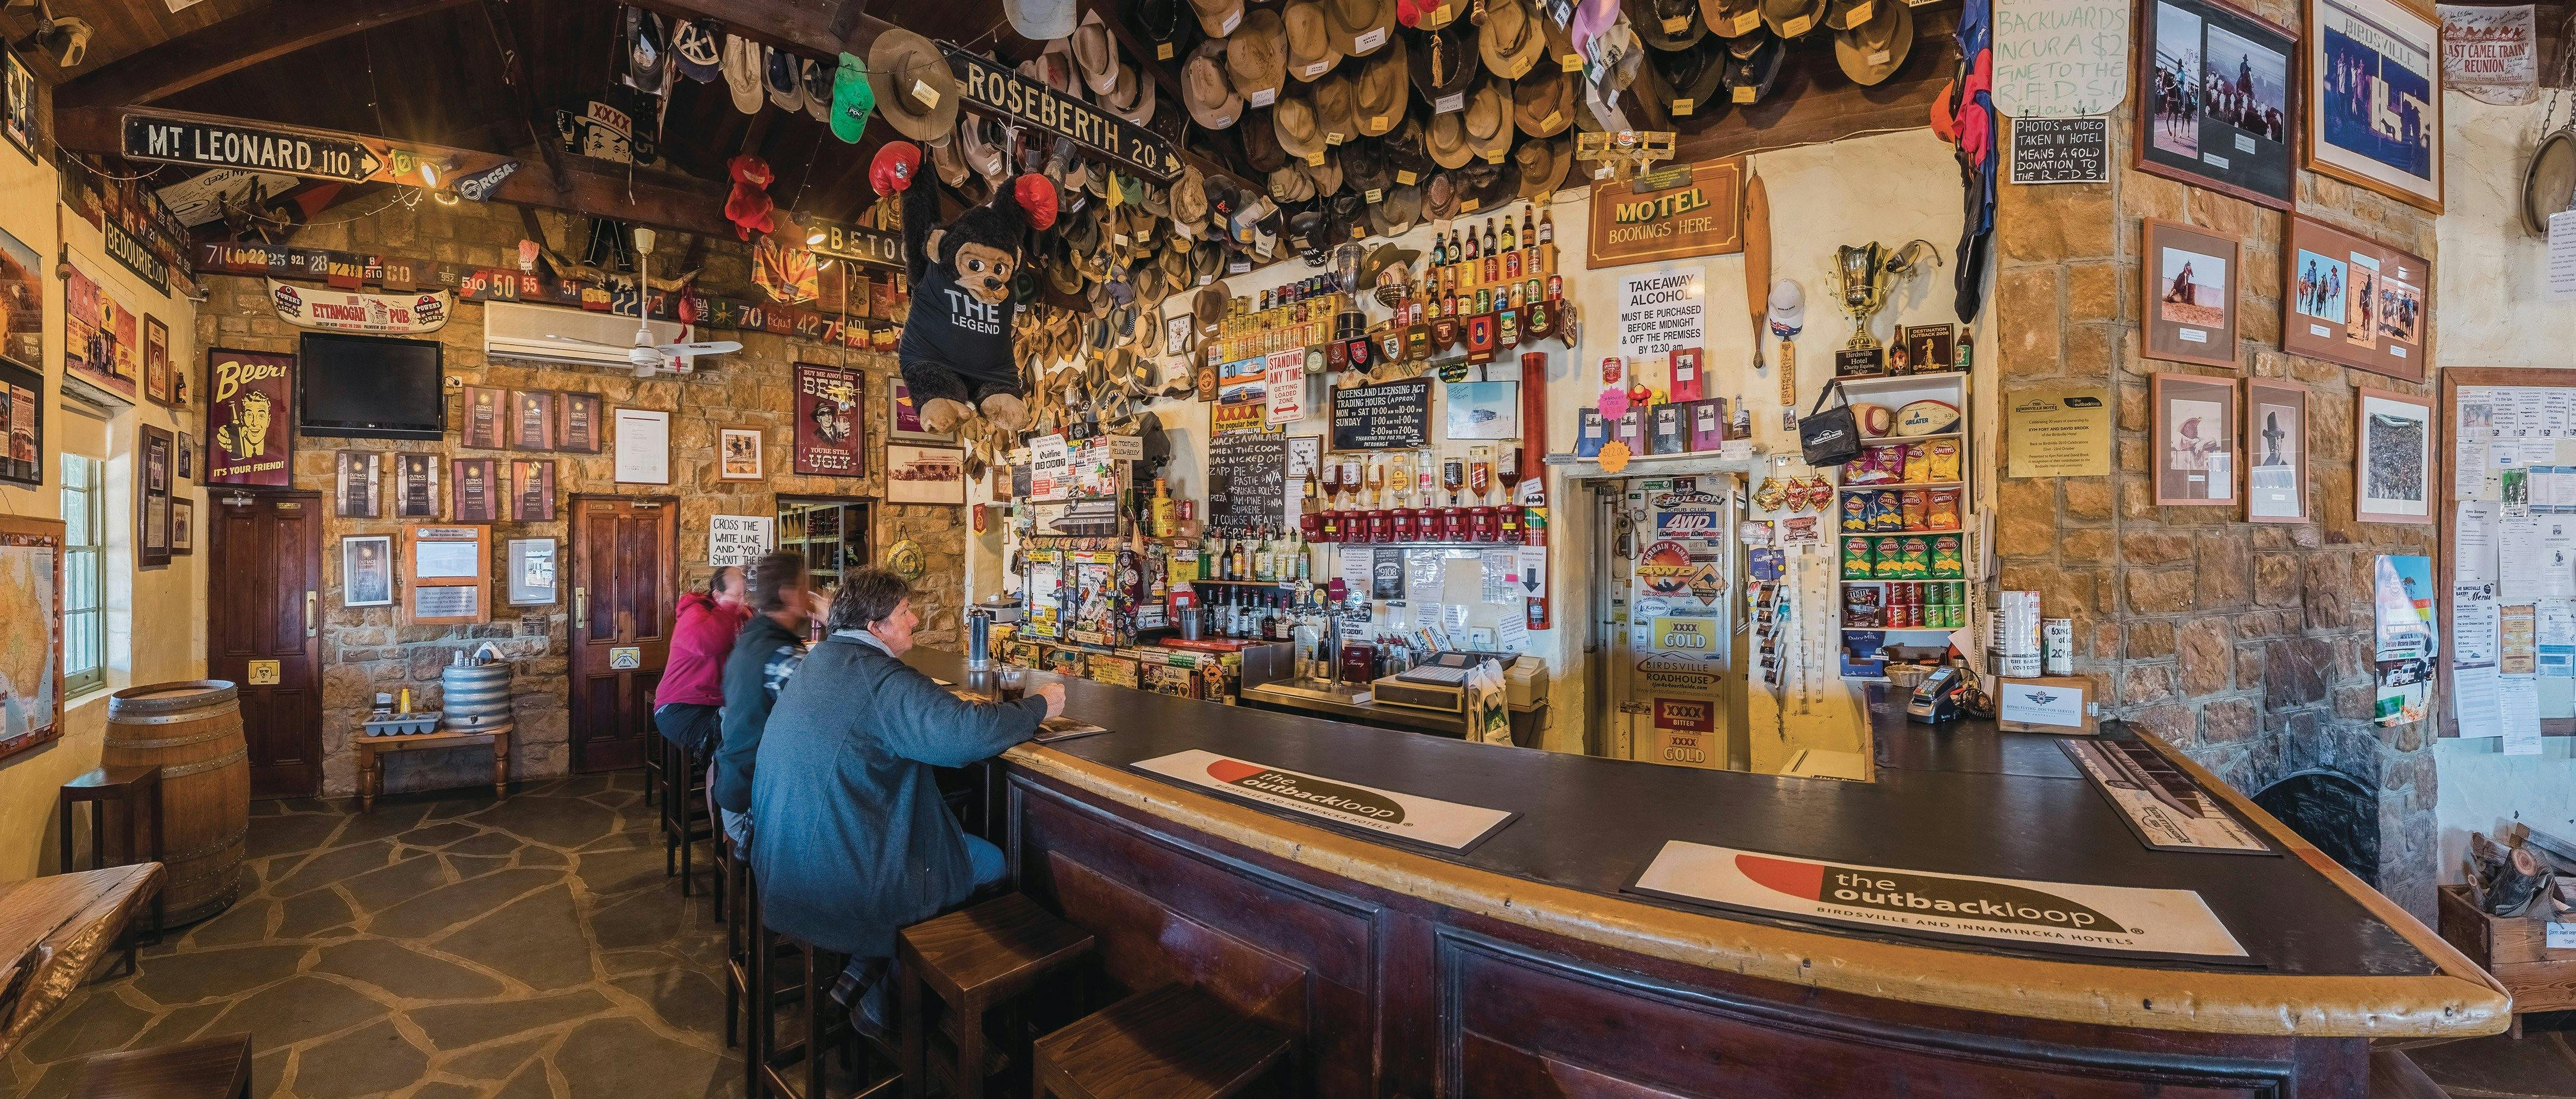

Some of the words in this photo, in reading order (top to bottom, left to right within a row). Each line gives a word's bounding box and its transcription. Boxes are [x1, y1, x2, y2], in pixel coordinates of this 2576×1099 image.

[1997, 8, 2126, 36] BACKWARDS
[2091, 32, 2124, 60] $2
[2344, 17, 2414, 68] BIRDSVILLE
[2468, 45, 2496, 58] CAMEL
[1997, 62, 2038, 82] FINE
[2044, 60, 2073, 79] TO
[2081, 62, 2123, 78] THE
[2464, 60, 2505, 73] REUNION
[594, 104, 630, 133] XXXX
[968, 62, 1119, 154] ROSEBERTH
[1132, 138, 1155, 167] 20
[2074, 121, 2104, 130] VIDEO
[2019, 133, 2051, 145] TAKEN
[2057, 134, 2065, 144] IN
[2070, 132, 2102, 143] HOTEL
[195, 129, 312, 171] LEONARD
[322, 150, 350, 176] 110
[2018, 148, 2054, 159] MEANS
[2061, 148, 2068, 158] A
[2070, 147, 2099, 158] GOLD
[2017, 159, 2073, 171] DONATION
[2080, 159, 2096, 168] TO
[1616, 188, 1709, 222] MOTEL
[1609, 222, 1671, 244] BOOKINGS
[107, 222, 152, 277] BEDOURIE
[152, 262, 163, 285] 120
[268, 251, 286, 267] 25
[290, 255, 305, 265] 921
[311, 255, 327, 272] 28
[462, 277, 486, 290] 510
[493, 274, 514, 298] 50
[523, 277, 537, 292] 55
[1629, 274, 1694, 292] TAKEAWAY
[1631, 289, 1692, 306] ALCOHOL
[277, 305, 297, 316] LIGHT
[312, 303, 366, 321] ETTAMOGAH
[389, 308, 410, 323] PUB
[944, 289, 999, 323] THE
[1622, 312, 1641, 321] MUST
[1644, 311, 1654, 319] BE
[1657, 305, 1701, 318] PURCHASED
[739, 305, 761, 327] 70
[797, 313, 818, 336] 42
[952, 314, 999, 334] LEGEND
[1628, 322, 1656, 332] BEFORE
[1660, 318, 1694, 329] MIDNIGHT
[1630, 334, 1644, 343] OFF
[1647, 333, 1660, 342] THE
[1663, 328, 1700, 340] PREMISES
[1638, 346, 1648, 354] BY
[1651, 344, 1669, 353] 12.30
[1270, 352, 1302, 370] STANDING
[1225, 364, 1236, 379] 30
[1270, 371, 1283, 384] ANY
[1286, 367, 1302, 381] TIME
[1274, 384, 1298, 392] GETTING
[1337, 388, 1377, 398] QUEENSLAND
[1378, 386, 1409, 395] LICENSING
[1412, 384, 1425, 393] ACT
[1337, 399, 1364, 408] TRADING
[1365, 397, 1386, 406] HOURS
[1388, 393, 1416, 404] (APPROX)
[1226, 421, 1245, 430] popular
[1336, 418, 1362, 426] SUNDAY
[809, 454, 850, 469] UGLY
[1229, 455, 1264, 464] NICKED
[1267, 454, 1284, 463] OFF
[213, 468, 228, 477] IT'S
[230, 466, 252, 475] YOUR
[253, 461, 284, 473] FRIEND!
[1234, 466, 1246, 476] PIE
[1666, 495, 1721, 504] BOLTON
[714, 519, 738, 530] CROSS
[742, 521, 758, 531] THE
[1666, 514, 1710, 529] 4WD
[715, 533, 738, 543] WHITE
[741, 535, 760, 543] LINE
[713, 555, 738, 565] SHOUT
[742, 556, 756, 565] THE
[2468, 591, 2491, 601] Menu
[1665, 633, 1706, 648] GOLD
[1647, 662, 1708, 672] BIRDSVILLE
[1647, 674, 1708, 684] ROADHOUSE
[1663, 747, 1705, 763] GOLD
[1259, 772, 1296, 785] the
[1215, 784, 1263, 799] BIRDSVILLE
[1286, 803, 1347, 819] INNAMINCKA
[1350, 818, 1390, 829] HOTELS
[1835, 872, 1896, 891] the
[1817, 906, 1909, 923] BIRDSVILLE
[1916, 918, 1950, 928] AND
[1957, 923, 2064, 939] INNAMINCKA
[2070, 934, 2134, 945] HOTELS
